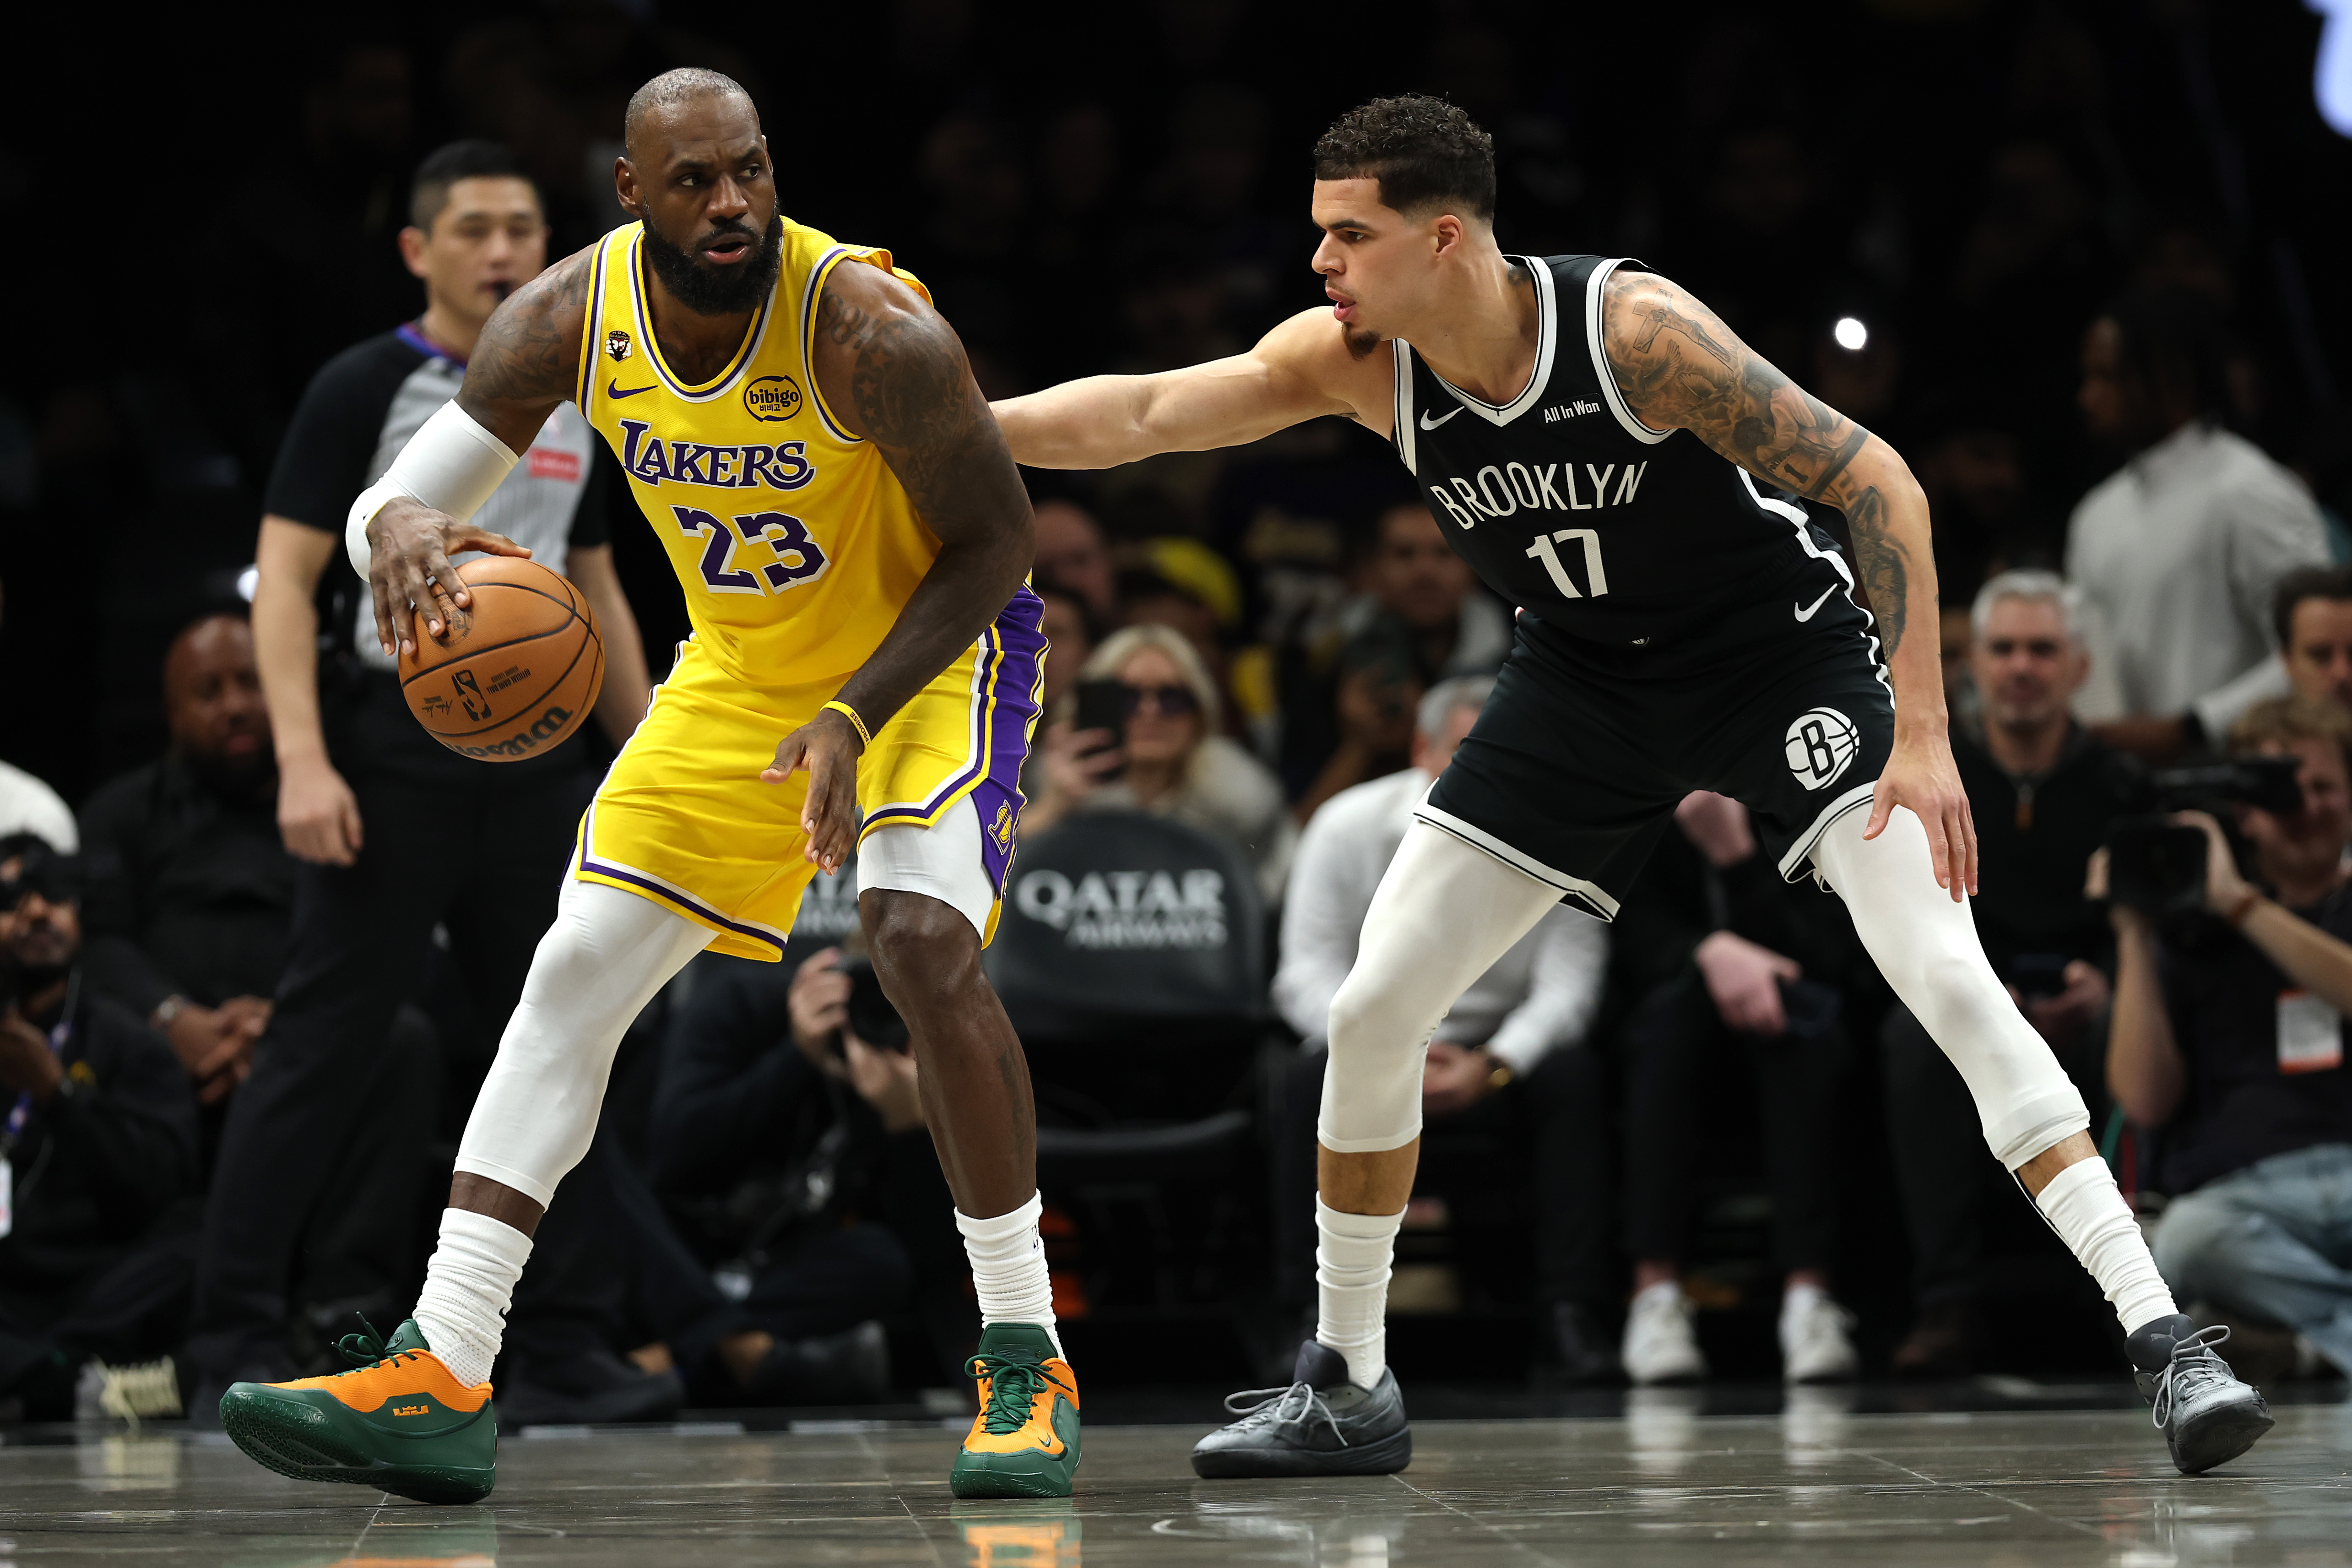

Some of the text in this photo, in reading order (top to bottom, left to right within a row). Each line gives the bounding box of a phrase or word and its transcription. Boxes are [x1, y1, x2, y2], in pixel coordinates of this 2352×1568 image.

[749, 387, 799, 407] bibigo
[1544, 400, 1600, 423] All In Won
[618, 418, 817, 492] LAKERS
[1430, 461, 1647, 530] BROOKLYN
[669, 504, 831, 597] 23
[1525, 529, 1608, 598] 17
[849, 711, 869, 743] PROMISE
[1800, 720, 1835, 780] B
[1015, 869, 1225, 930] QATAR
